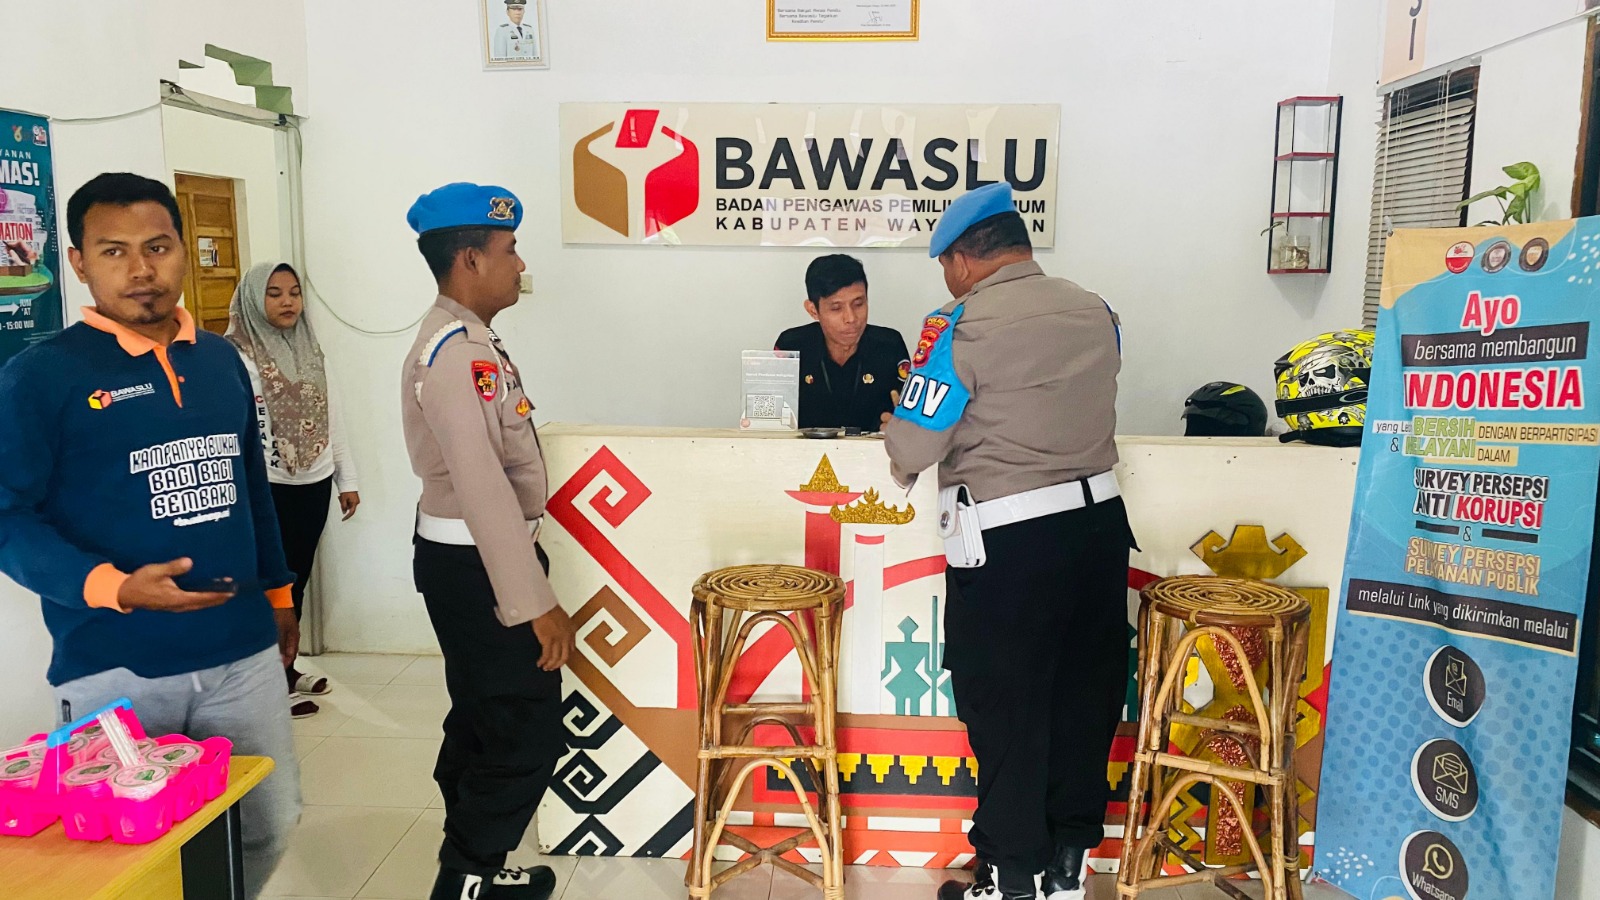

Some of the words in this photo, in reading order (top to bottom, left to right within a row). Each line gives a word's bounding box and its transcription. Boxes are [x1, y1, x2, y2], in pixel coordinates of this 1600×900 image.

[716, 138, 1047, 191] BAWASLU
[716, 198, 777, 212] BADAN
[783, 199, 883, 213] PENGAWAS
[889, 199, 952, 213] PEMILI
[1014, 200, 1046, 214] UM
[716, 217, 867, 231] KABUPATEN
[888, 218, 937, 232] WAY
[1461, 291, 1520, 335] Ayo
[1414, 340, 1476, 361] bersama
[1481, 334, 1576, 360] membangun
[111, 382, 153, 397] BAWASLU
[1403, 368, 1583, 409] INDONESIA
[1376, 421, 1399, 434] yang
[1413, 416, 1476, 438] BERSIH
[1478, 425, 1518, 440] DENGAN
[1520, 426, 1599, 442] BERPARTISIPASI
[130, 438, 206, 472] KAMPANYE
[1390, 437, 1400, 453] &
[1477, 448, 1511, 462] DALAM
[150, 465, 196, 493] BAGI
[199, 460, 233, 483] BAGI
[1415, 466, 1471, 491] SURVEY
[1473, 473, 1550, 499] PERSEPSI
[152, 483, 237, 518] SEMBAKO
[1415, 491, 1451, 517] ANTI
[1456, 495, 1544, 528] KORUPSI
[1462, 525, 1472, 542] &
[1462, 546, 1541, 577] PERSEPSI
[1486, 569, 1540, 596] PUBLIK
[1358, 588, 1405, 607] melalui
[1409, 593, 1431, 611] Link
[1433, 602, 1449, 620] yang
[1452, 604, 1520, 629] dikirimkan
[1524, 619, 1569, 640] melalui
[1446, 691, 1464, 714] Email
[1434, 786, 1460, 810] SMS
